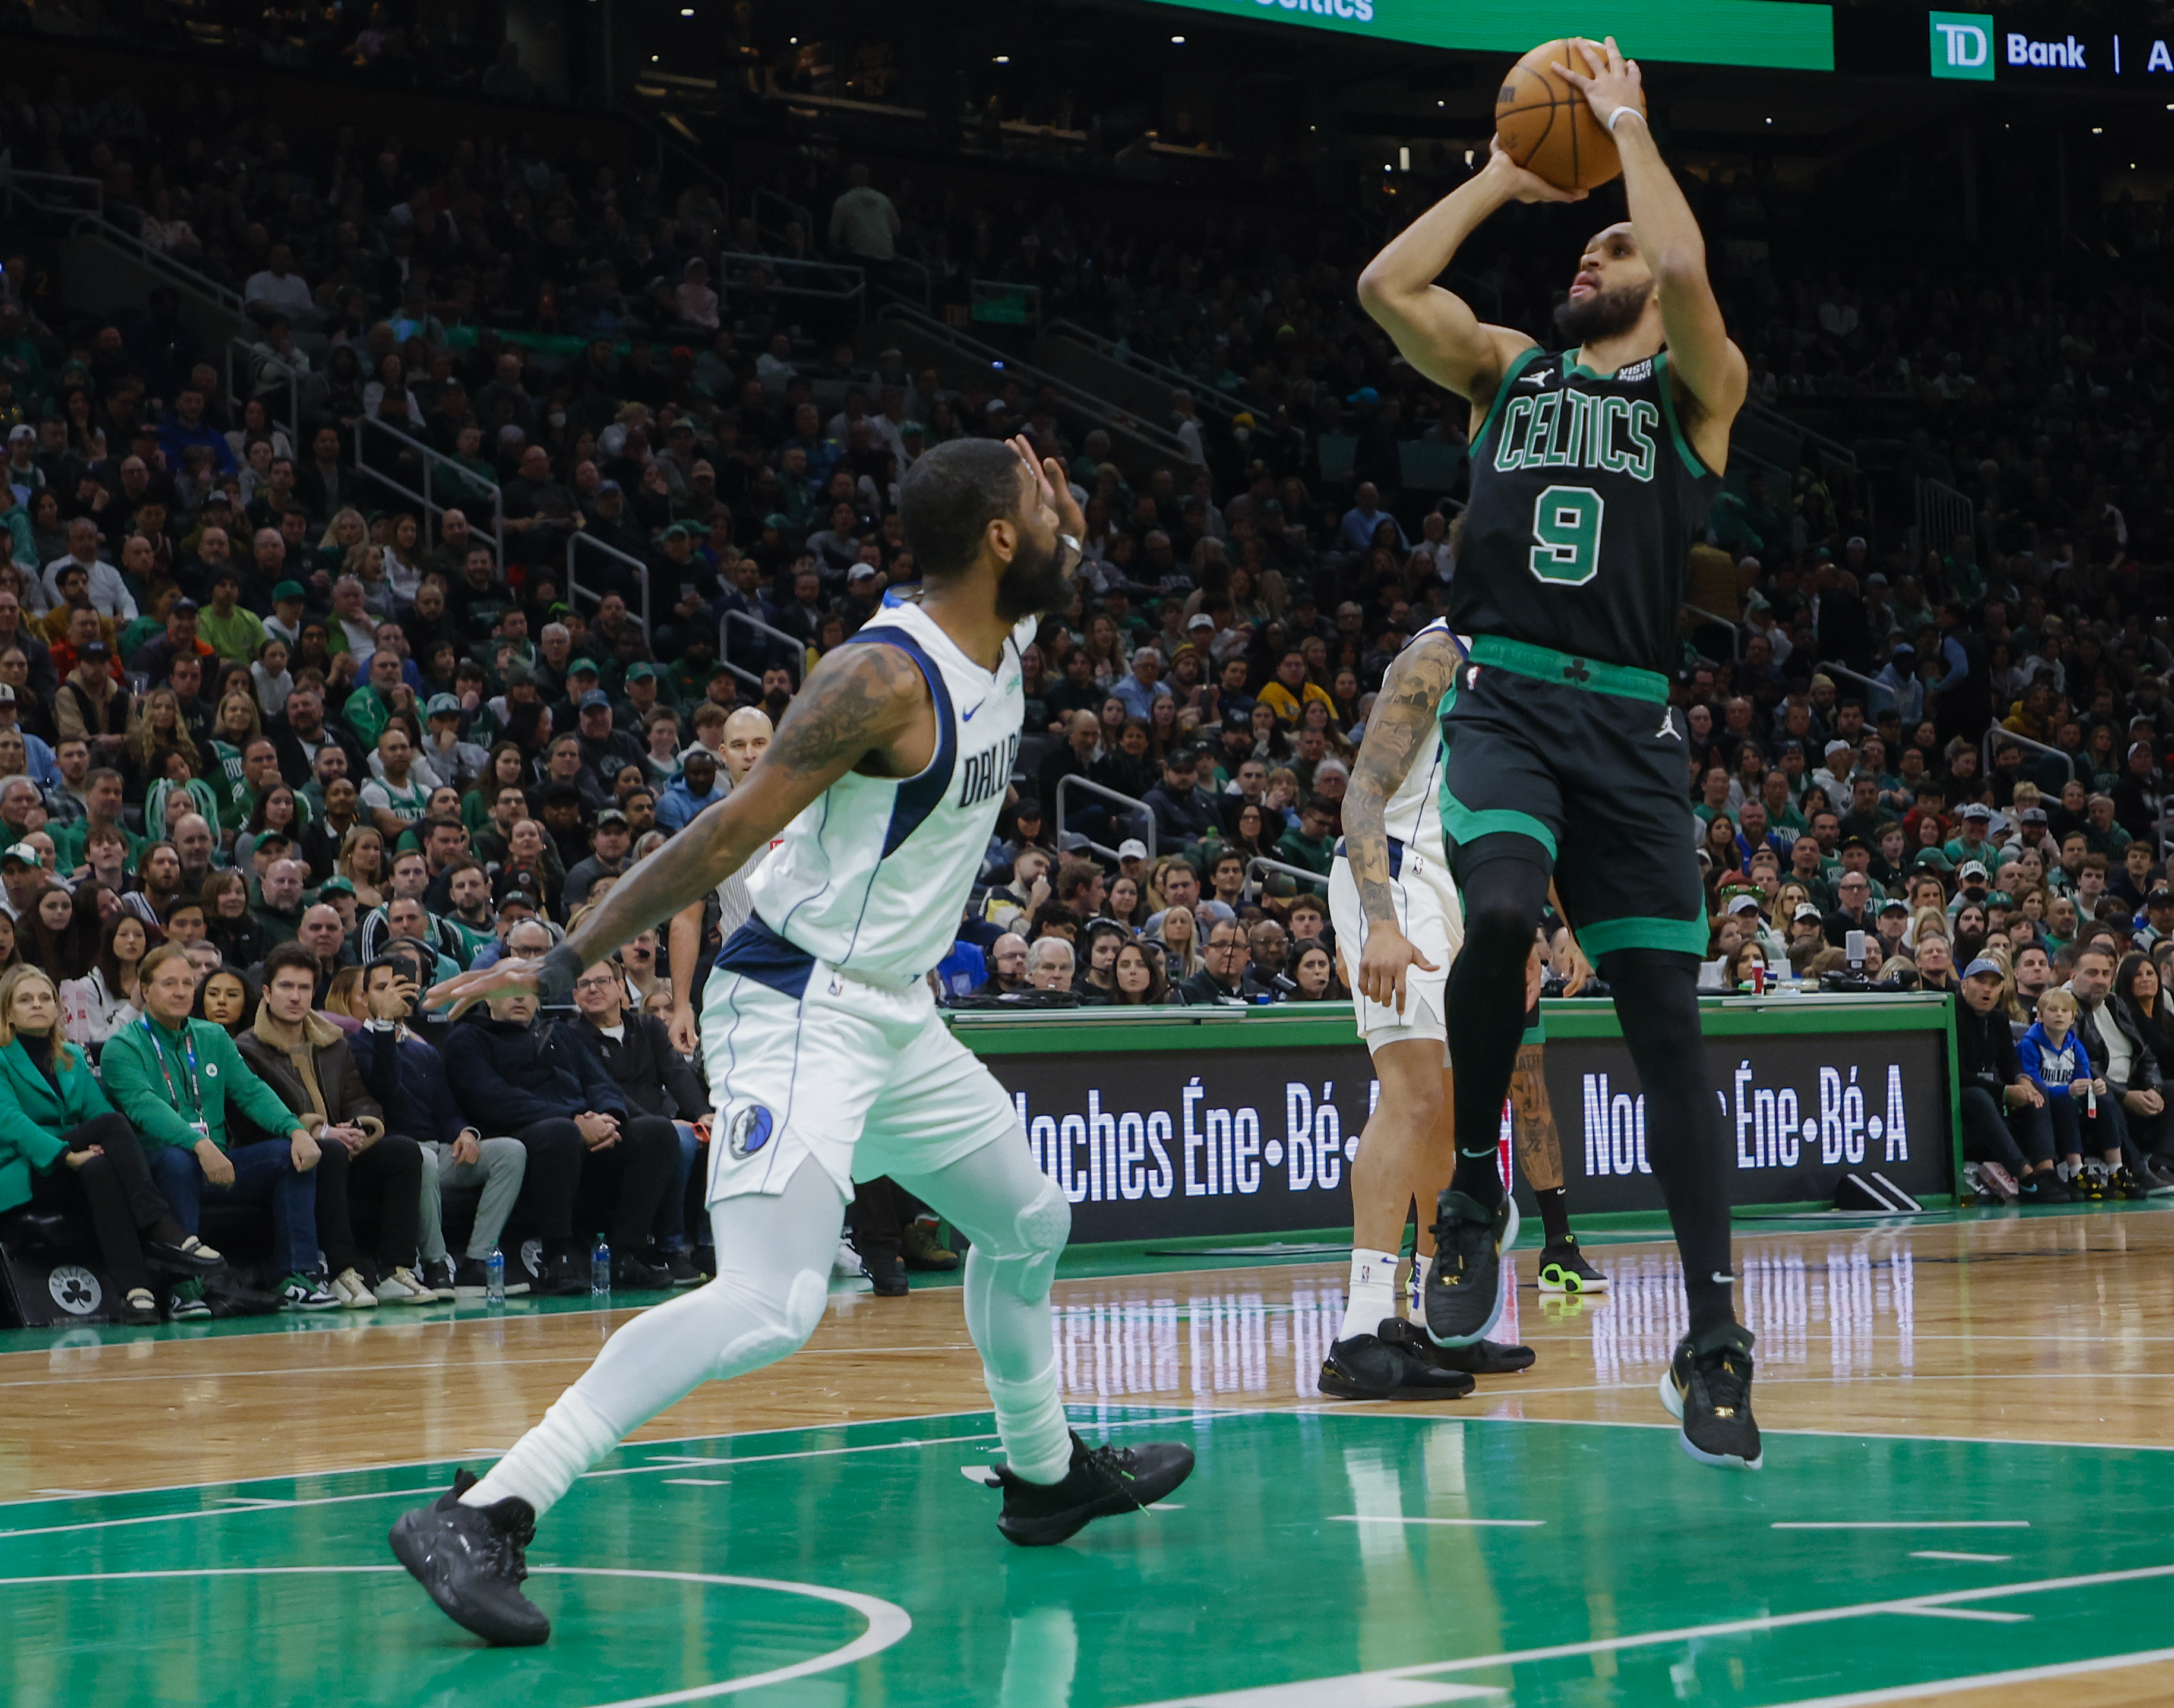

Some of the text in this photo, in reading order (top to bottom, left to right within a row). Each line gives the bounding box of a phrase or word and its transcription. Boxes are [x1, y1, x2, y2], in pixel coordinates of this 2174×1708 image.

[1935, 23, 1987, 67] TD
[2007, 32, 2087, 69] Bank
[1617, 368, 1651, 382] PRINT
[1619, 358, 1652, 375] VISTA
[1493, 387, 1659, 482] CELTICS
[1528, 485, 1604, 586] 9
[958, 726, 1023, 808] DALLA
[1015, 1088, 1175, 1203] oches
